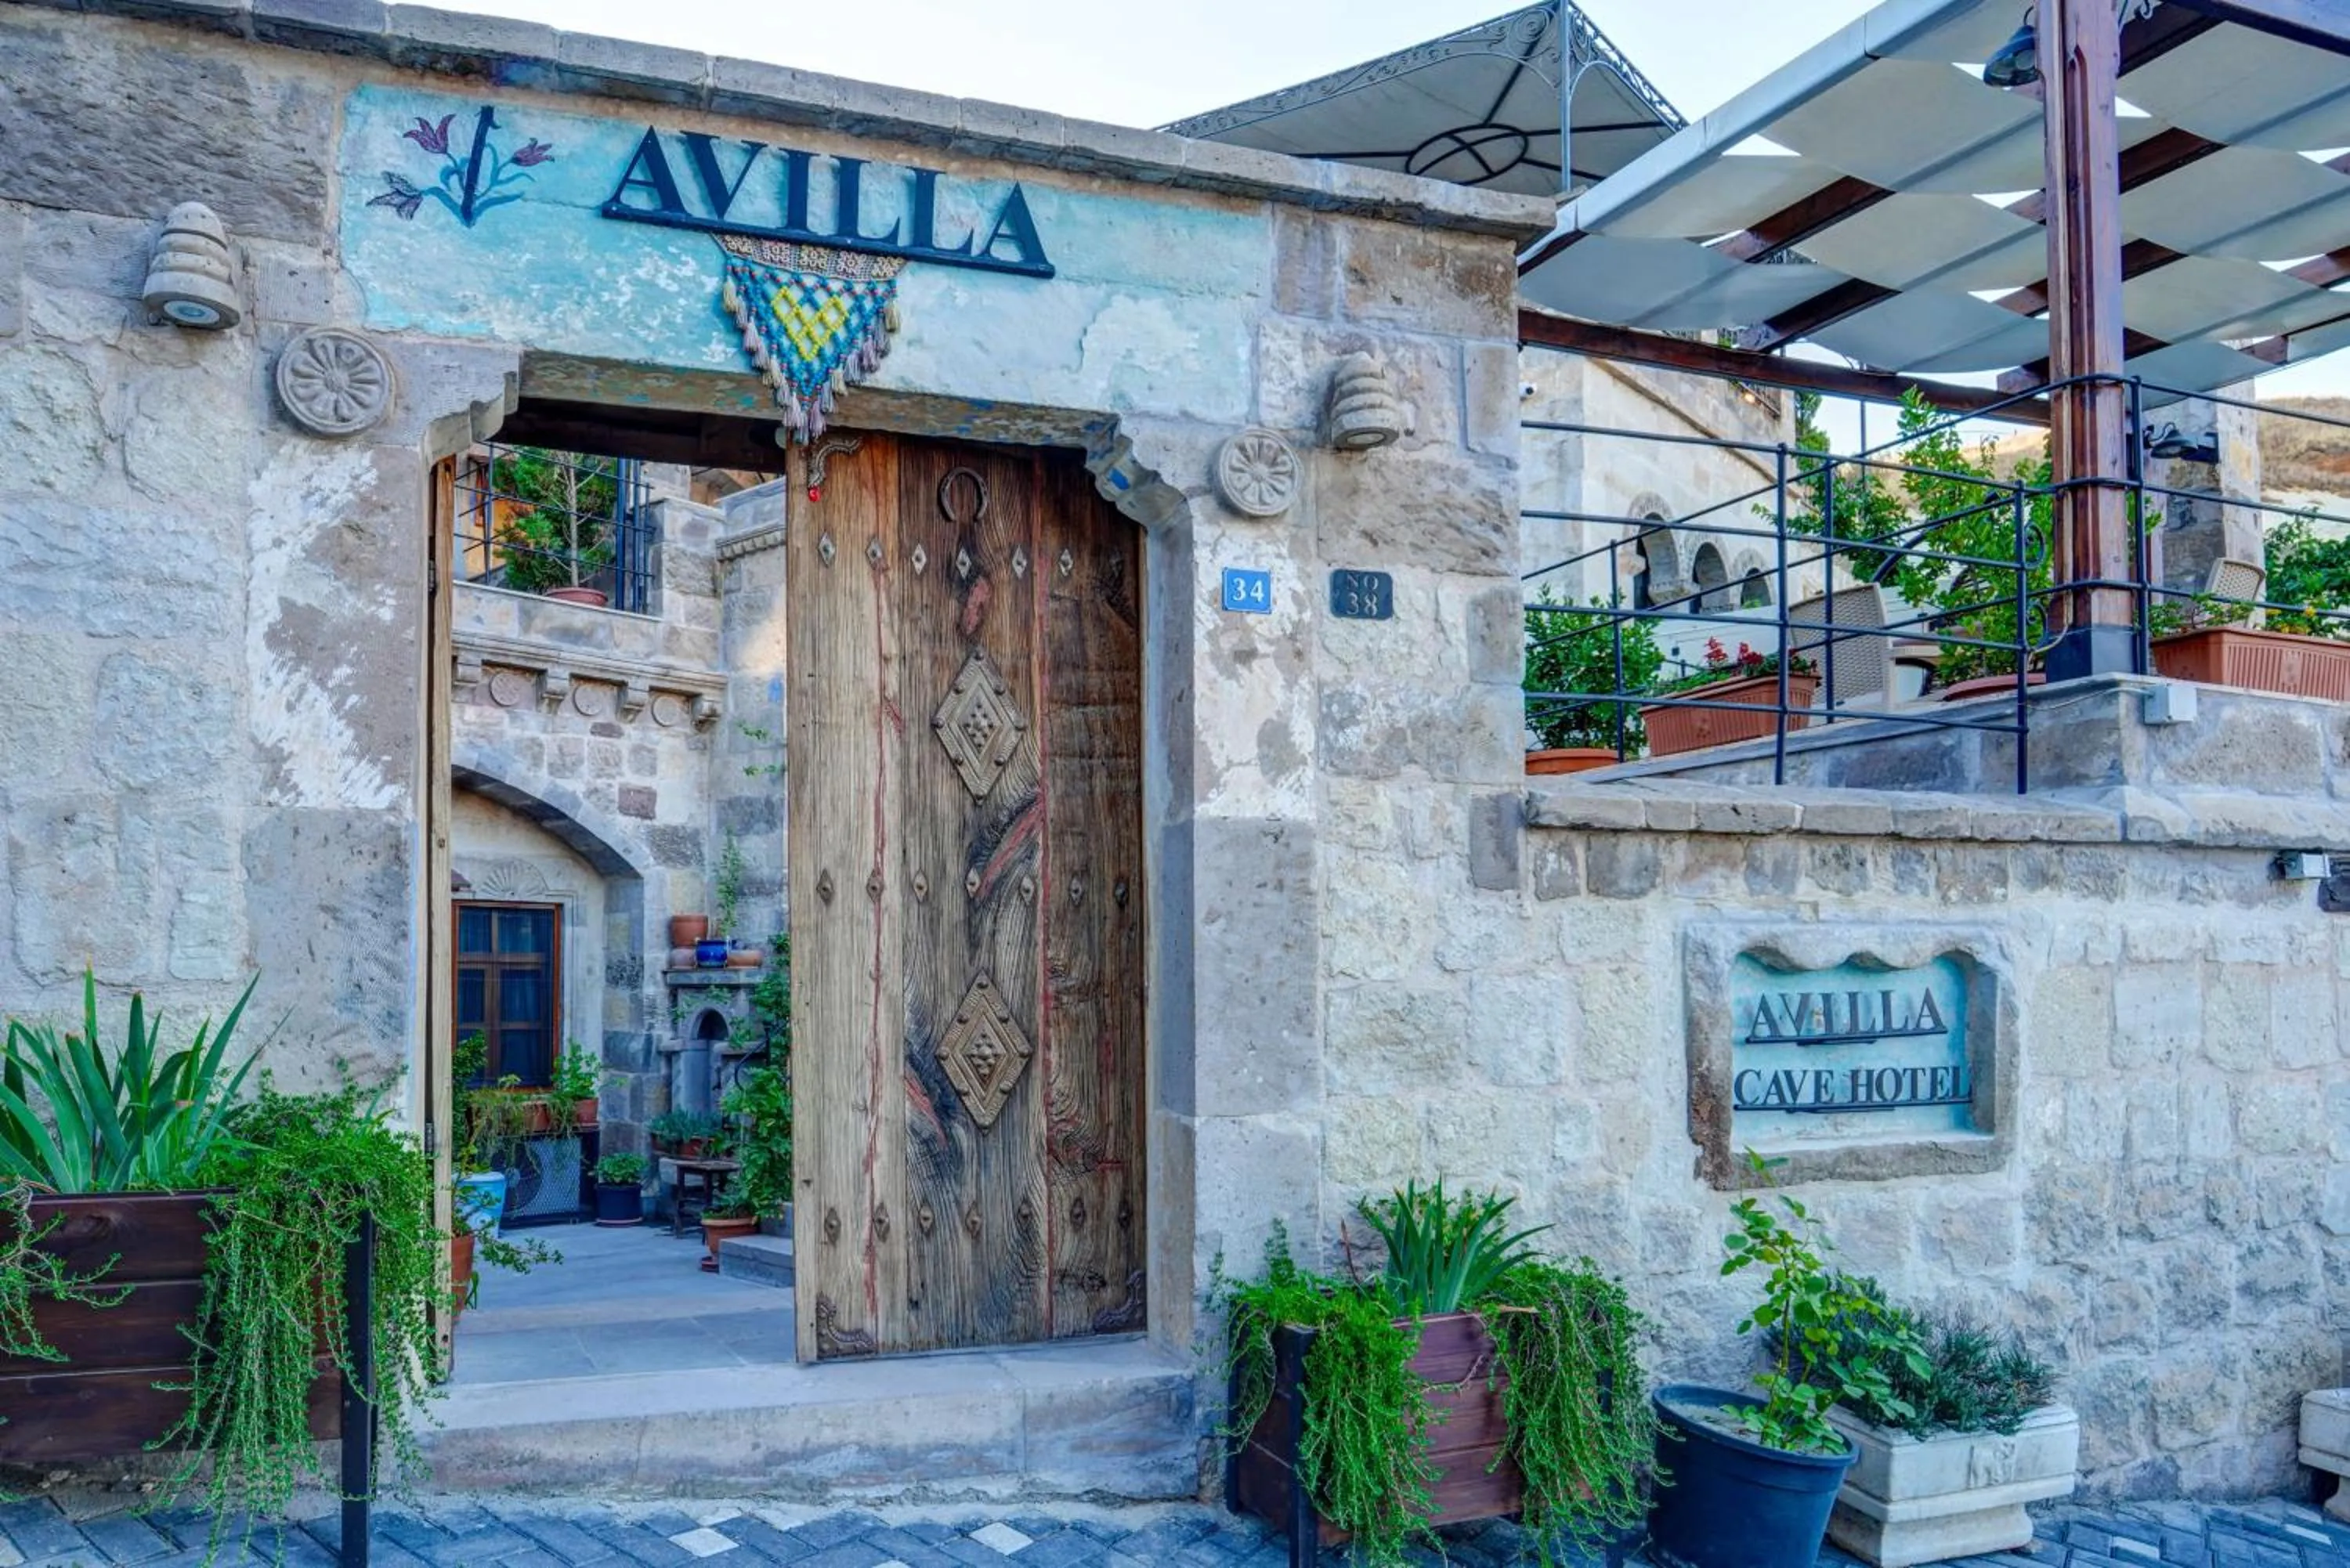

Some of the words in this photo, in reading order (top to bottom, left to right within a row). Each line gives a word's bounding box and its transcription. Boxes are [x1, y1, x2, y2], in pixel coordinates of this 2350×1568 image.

[603, 125, 1054, 274] AVILLA
[1232, 577, 1265, 602] 34
[1347, 573, 1379, 591] NO
[1347, 592, 1378, 616] 38
[1748, 987, 1947, 1039] AVILLA
[1734, 1068, 1835, 1105] CAVE
[1850, 1065, 1972, 1104] HOTEL
